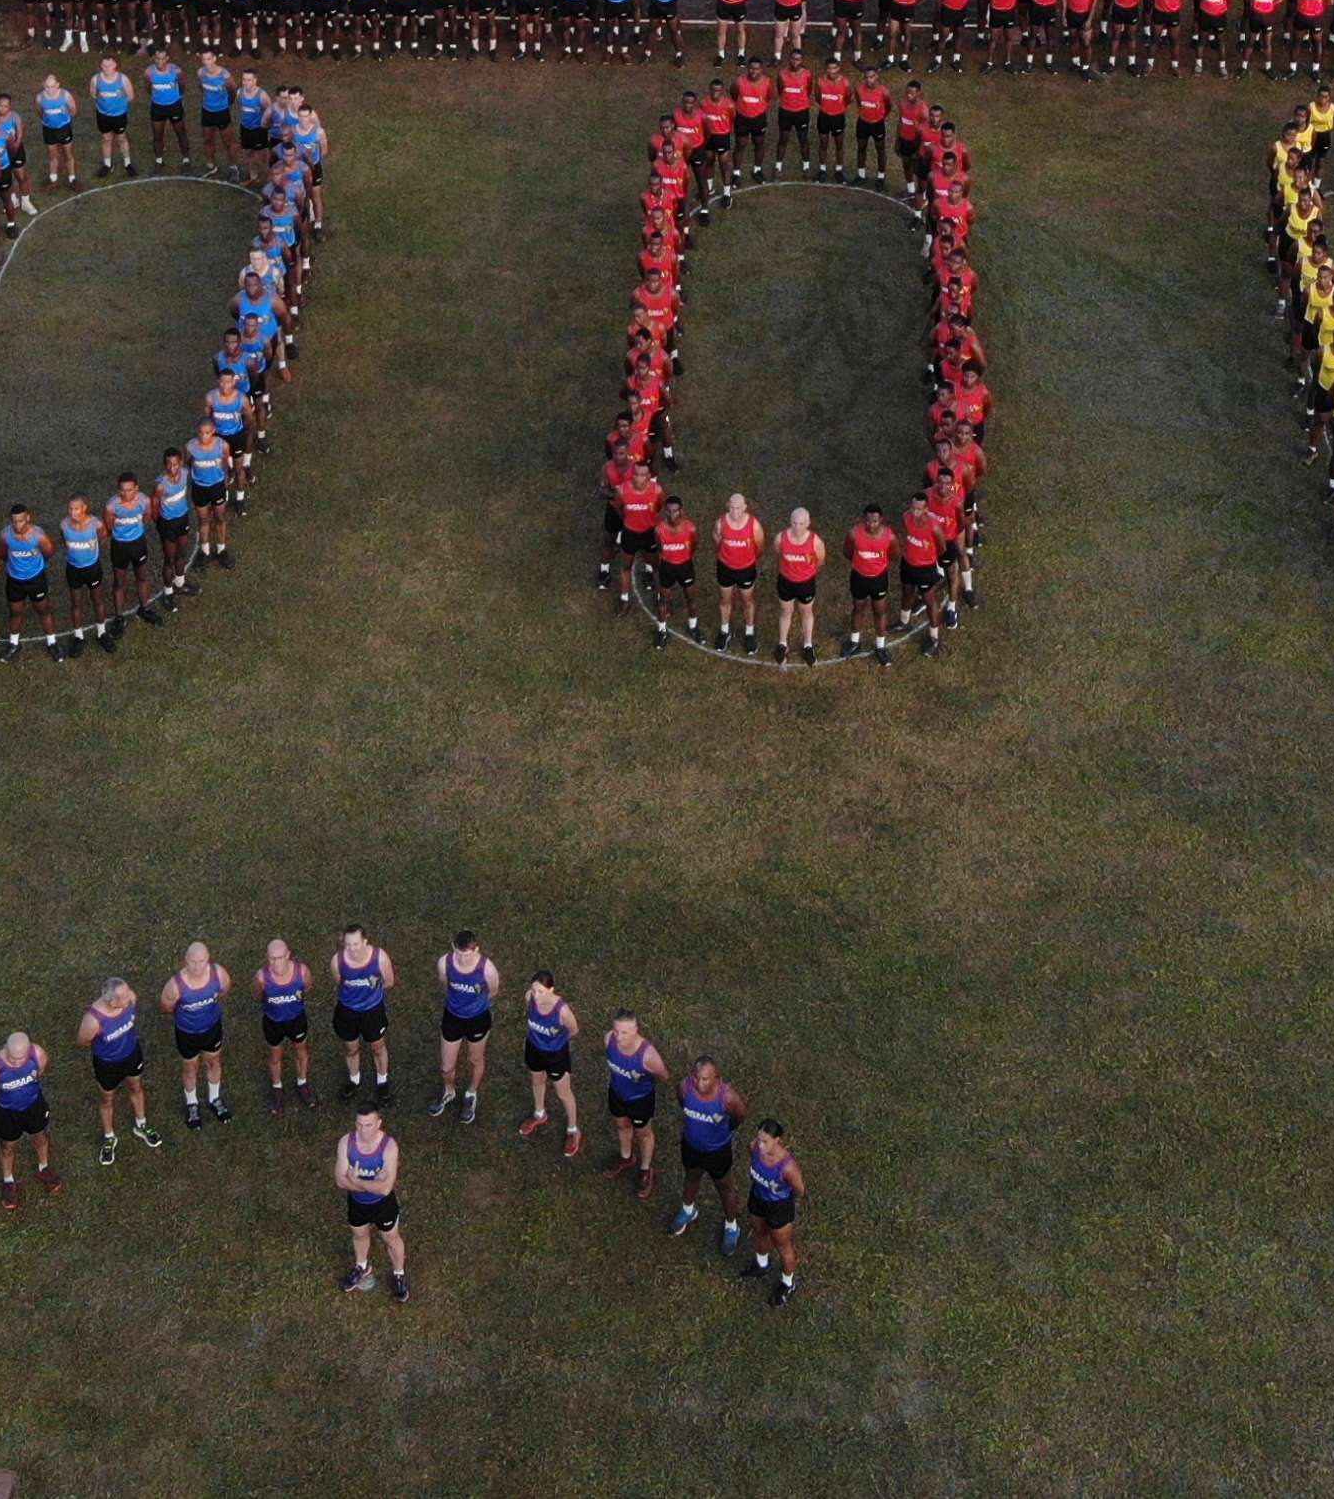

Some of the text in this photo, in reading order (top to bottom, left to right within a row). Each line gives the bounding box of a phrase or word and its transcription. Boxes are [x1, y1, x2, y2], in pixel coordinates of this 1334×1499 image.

[268, 995, 297, 1004] RSMA
[3, 1076, 33, 1090] RSMA
[684, 1107, 714, 1123] RSMA
